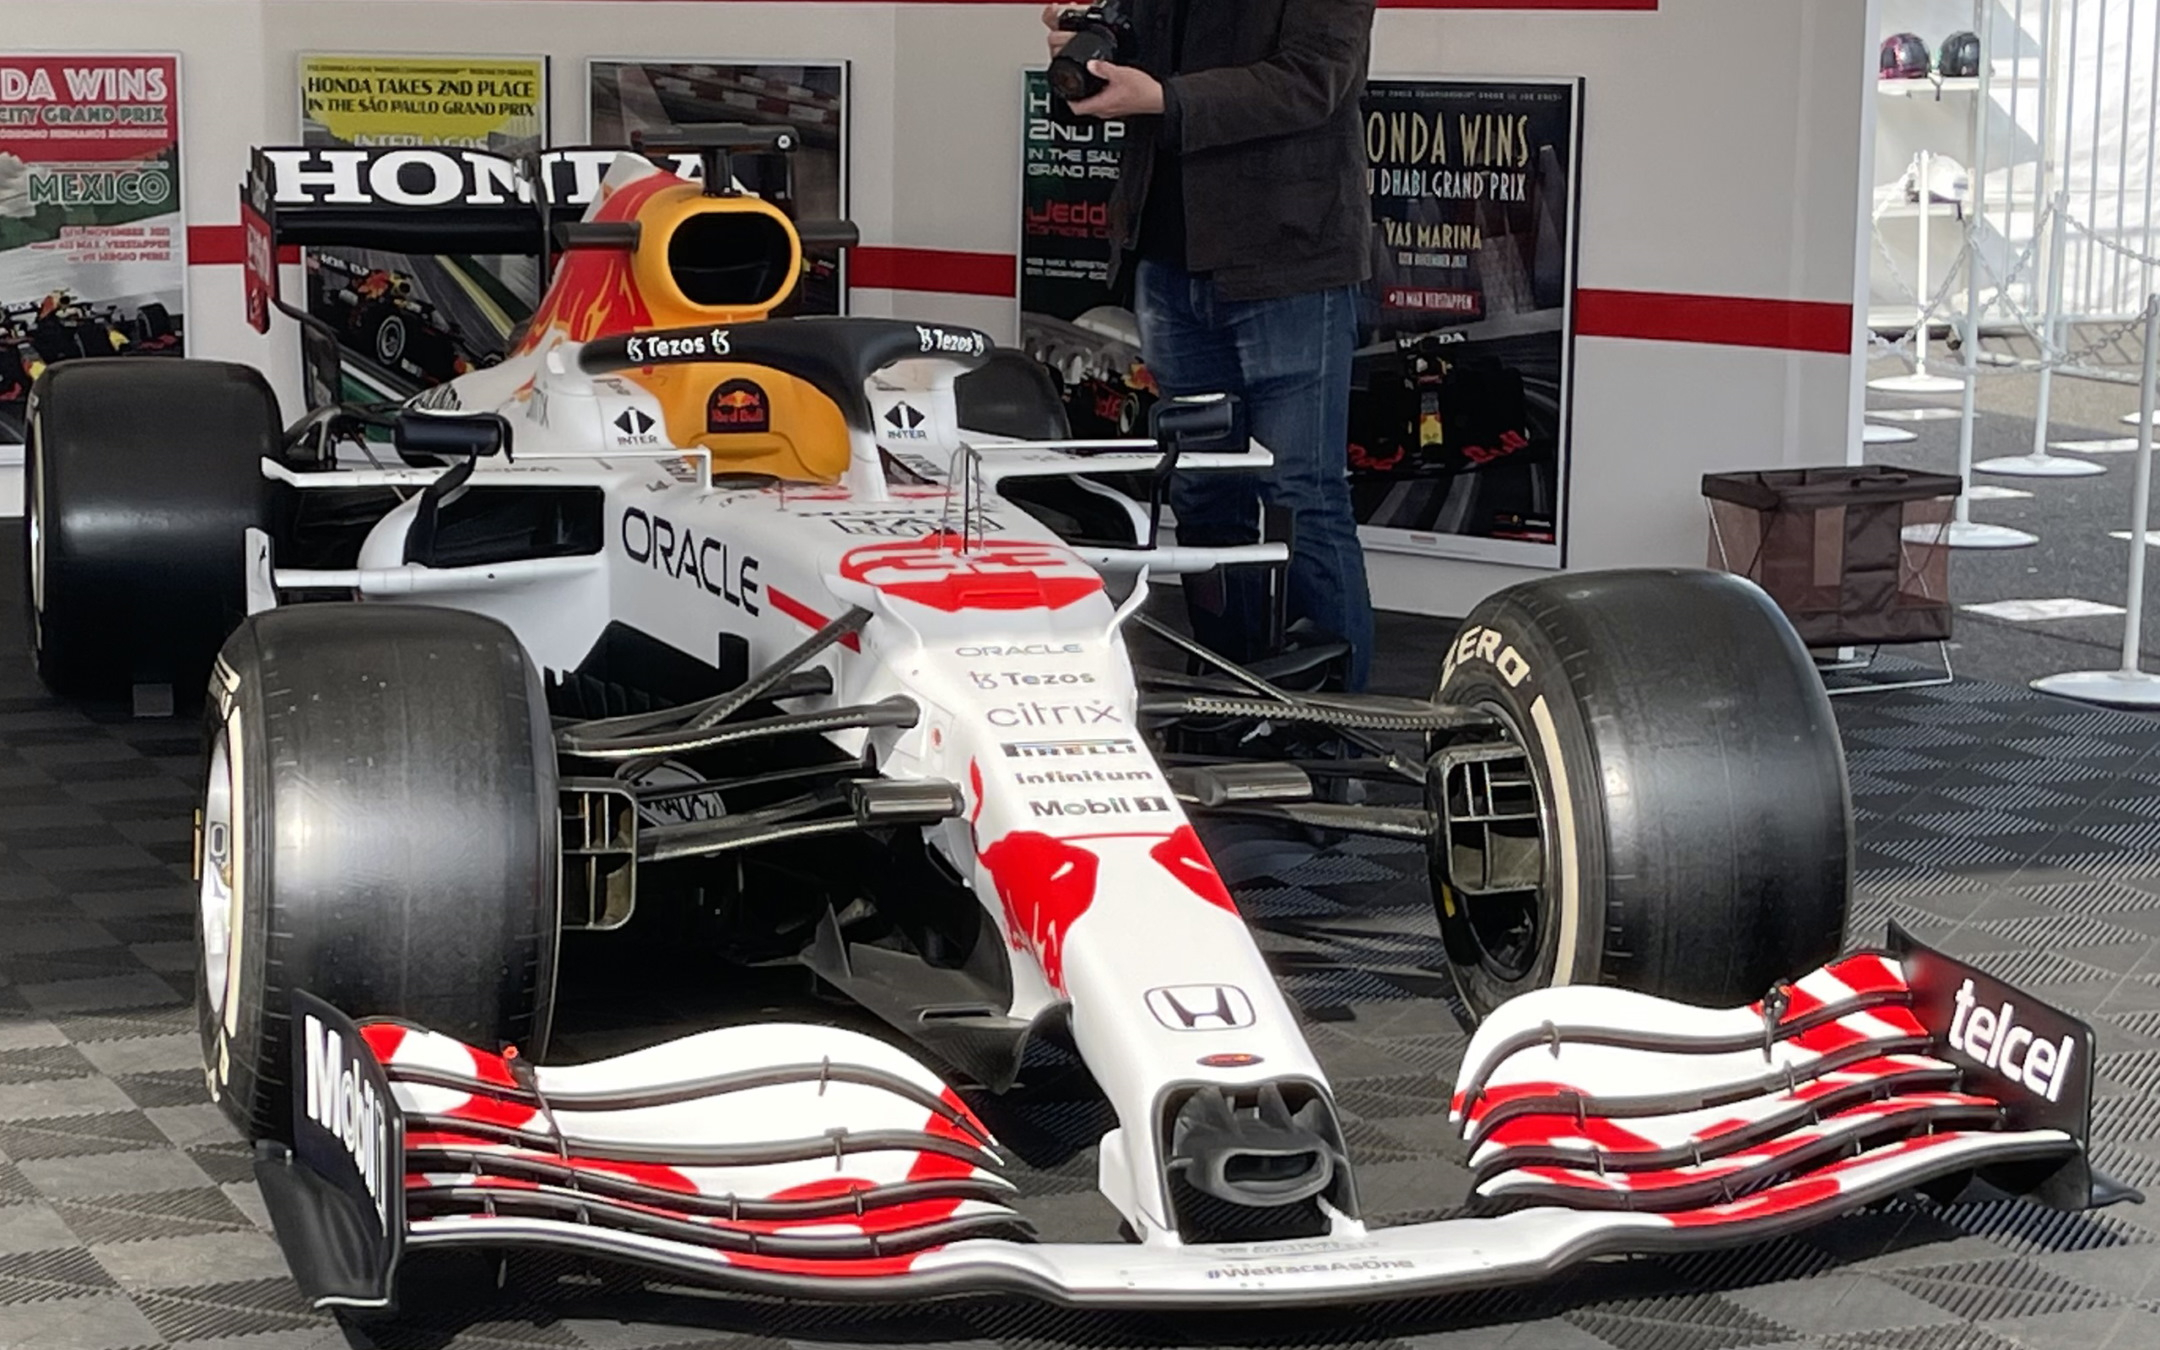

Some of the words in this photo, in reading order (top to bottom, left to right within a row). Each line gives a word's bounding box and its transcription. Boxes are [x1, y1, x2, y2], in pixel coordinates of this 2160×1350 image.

[63, 68, 168, 101] WINS
[308, 77, 371, 94] HONDA
[377, 78, 432, 95] TAKES
[437, 80, 472, 96] 2ND
[478, 80, 534, 97] PLACE
[42, 105, 116, 125] GRAND
[118, 105, 168, 125] PRIX
[308, 98, 323, 112] IN
[328, 99, 354, 113] THE
[359, 97, 388, 113] SÃO
[391, 100, 438, 114] PAULO
[443, 101, 495, 115] GRAND
[500, 102, 534, 116] PRIX
[1029, 118, 1093, 142] 2ND
[1367, 111, 1446, 165] ONDA
[1460, 113, 1528, 168] WINS
[1028, 147, 1043, 160] IN
[1048, 147, 1082, 162] THE
[1087, 149, 1120, 163] SAU
[1027, 163, 1085, 178] GRAND
[29, 172, 170, 204] MEXICO
[1432, 171, 1484, 199] GRAND
[1490, 172, 1526, 201] PRIX
[1027, 199, 1107, 226] Jedd
[1385, 222, 1412, 247] YAS
[1417, 223, 1482, 250] MARINA
[646, 337, 705, 357] Tezos
[932, 329, 973, 353] Tezos
[617, 435, 658, 445] INTER
[887, 429, 927, 440] INTER
[622, 506, 759, 617] ORACLE
[955, 643, 1083, 657] ORACLE
[1440, 625, 1531, 688] ZERO
[1001, 672, 1096, 686] Tezos
[1000, 738, 1138, 757] PIRELLI
[1028, 796, 1131, 817] Mobil
[1949, 978, 2075, 1102] telcel
[305, 1014, 375, 1198] Mobil
[1206, 1259, 1415, 1279] #WeRaceAsOne
